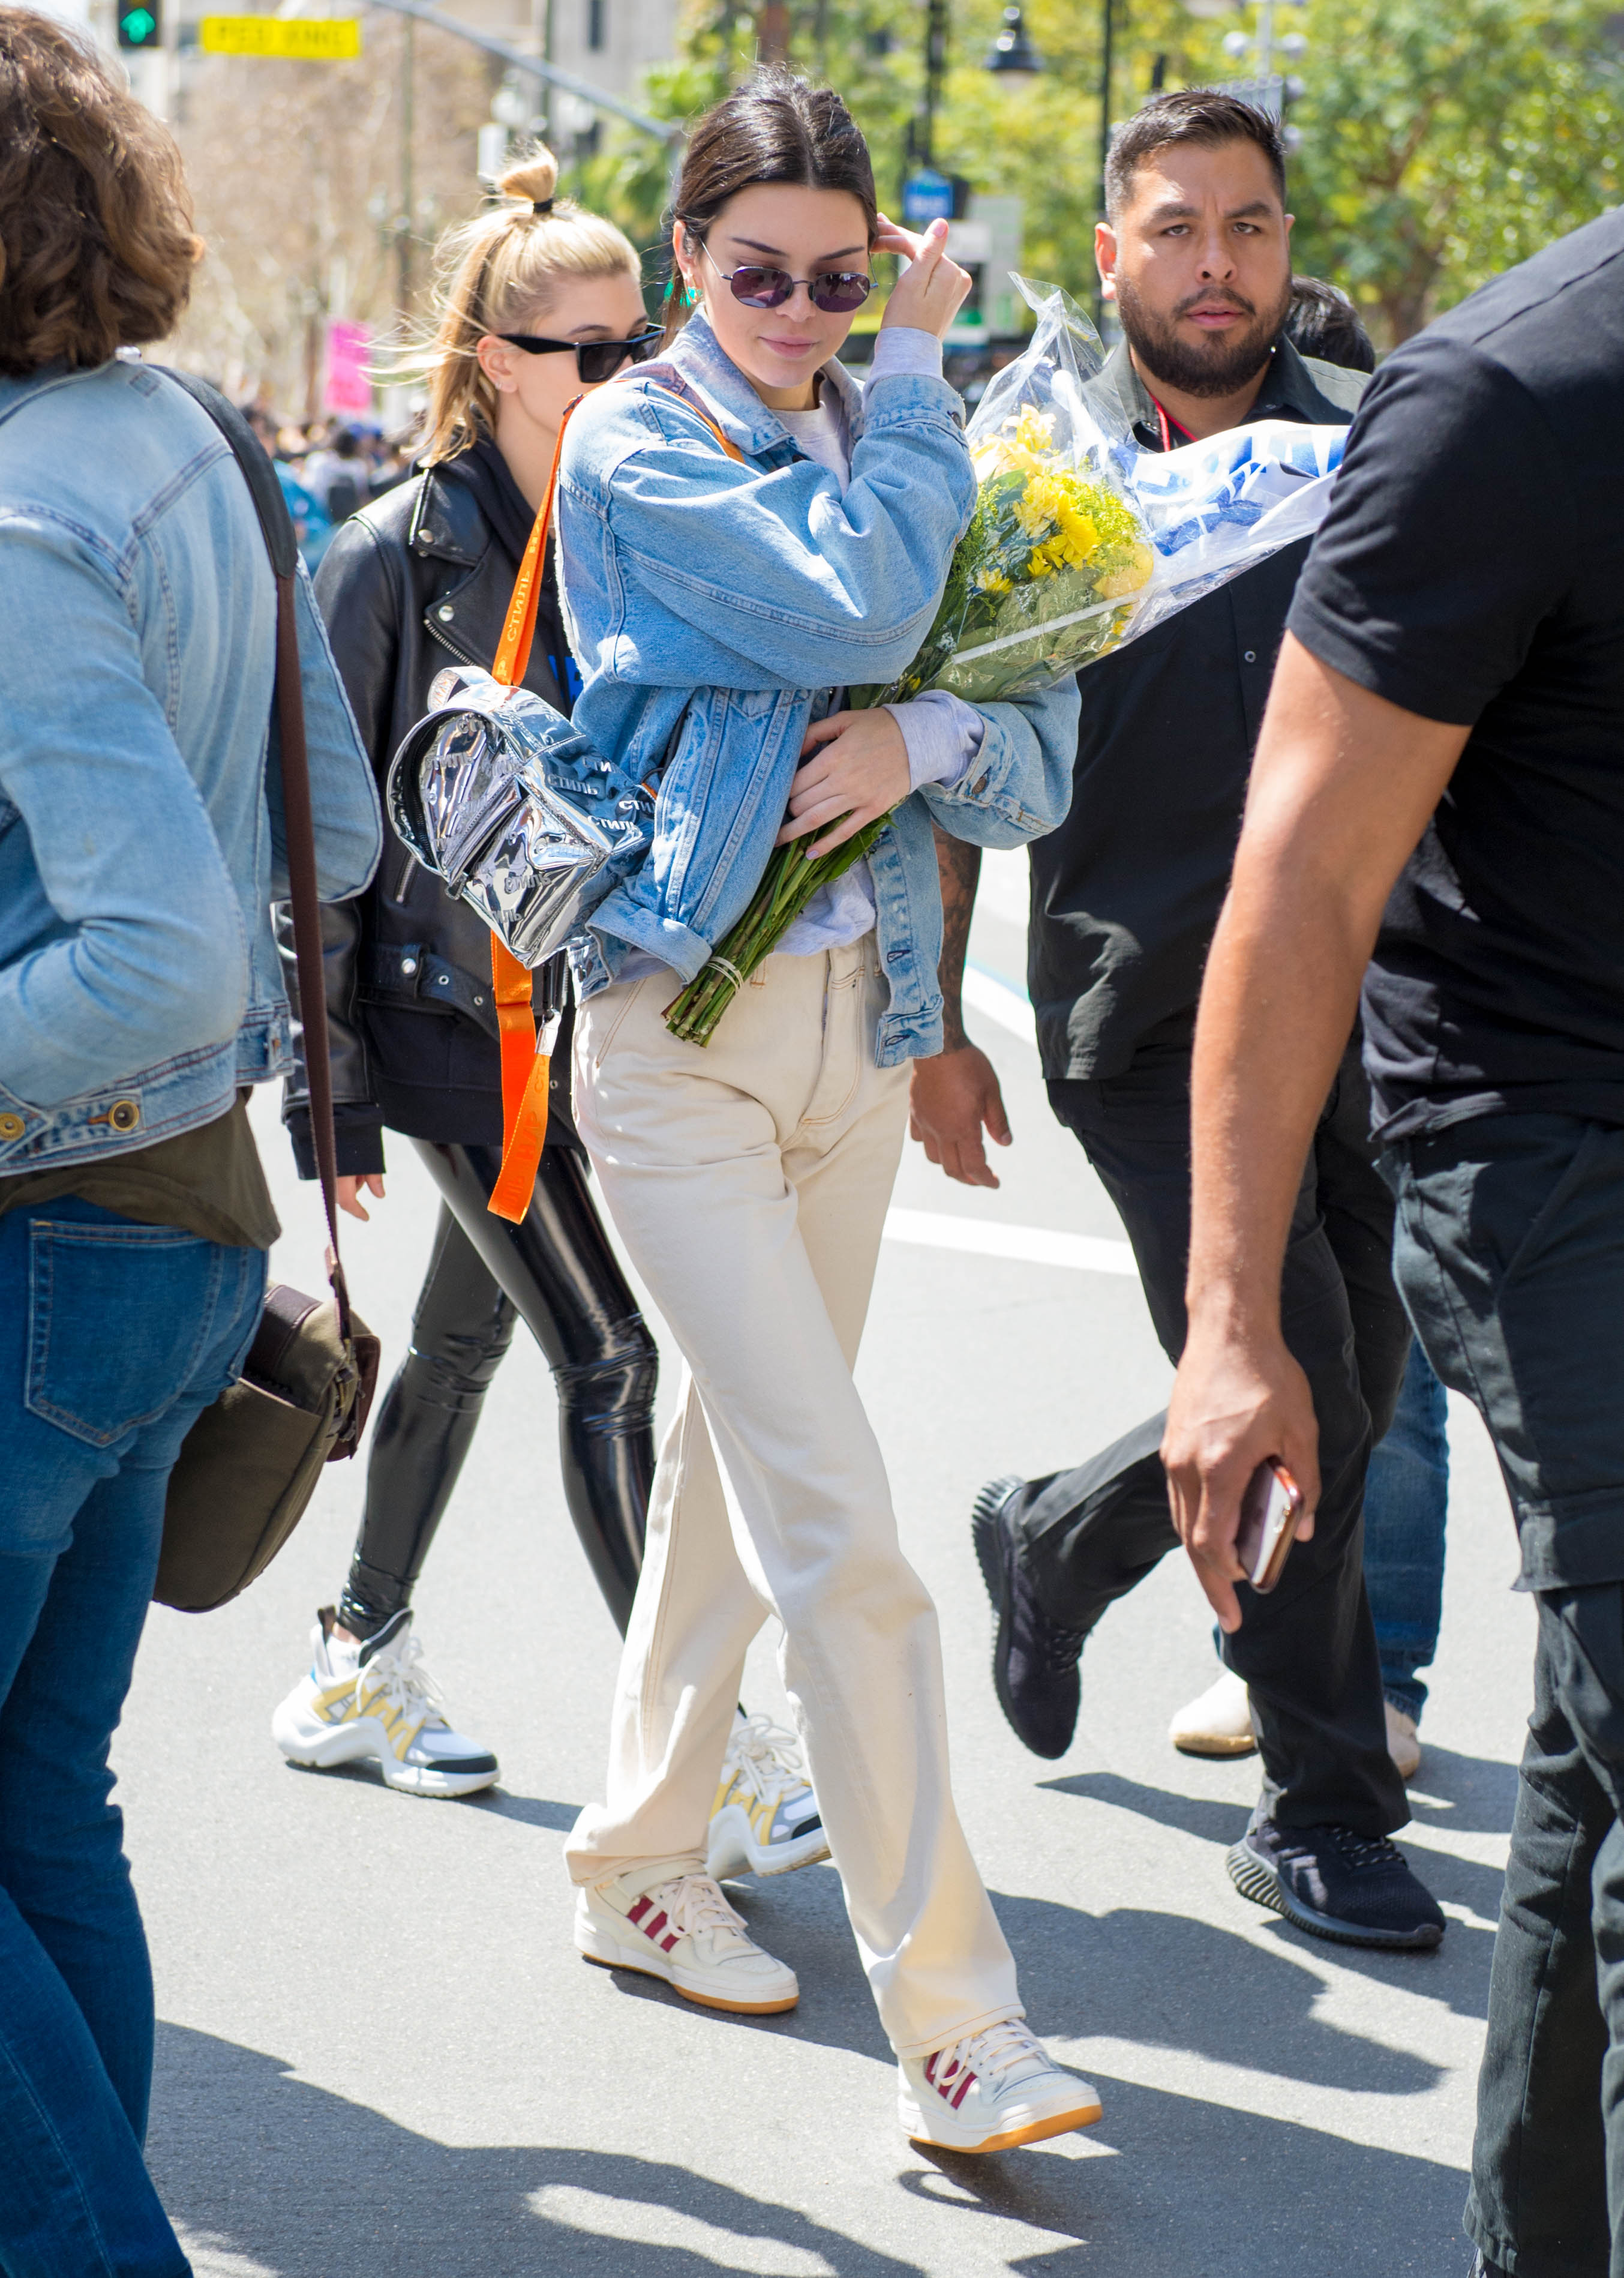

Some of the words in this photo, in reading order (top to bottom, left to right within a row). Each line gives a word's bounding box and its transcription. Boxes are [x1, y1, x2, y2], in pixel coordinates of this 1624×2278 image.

[507, 571, 530, 642] СТИЛЬ
[583, 757, 613, 773] СТИ
[547, 774, 598, 795] СТИЛЬ
[619, 800, 656, 814] СТИ
[493, 908, 523, 924] ИЛЬ
